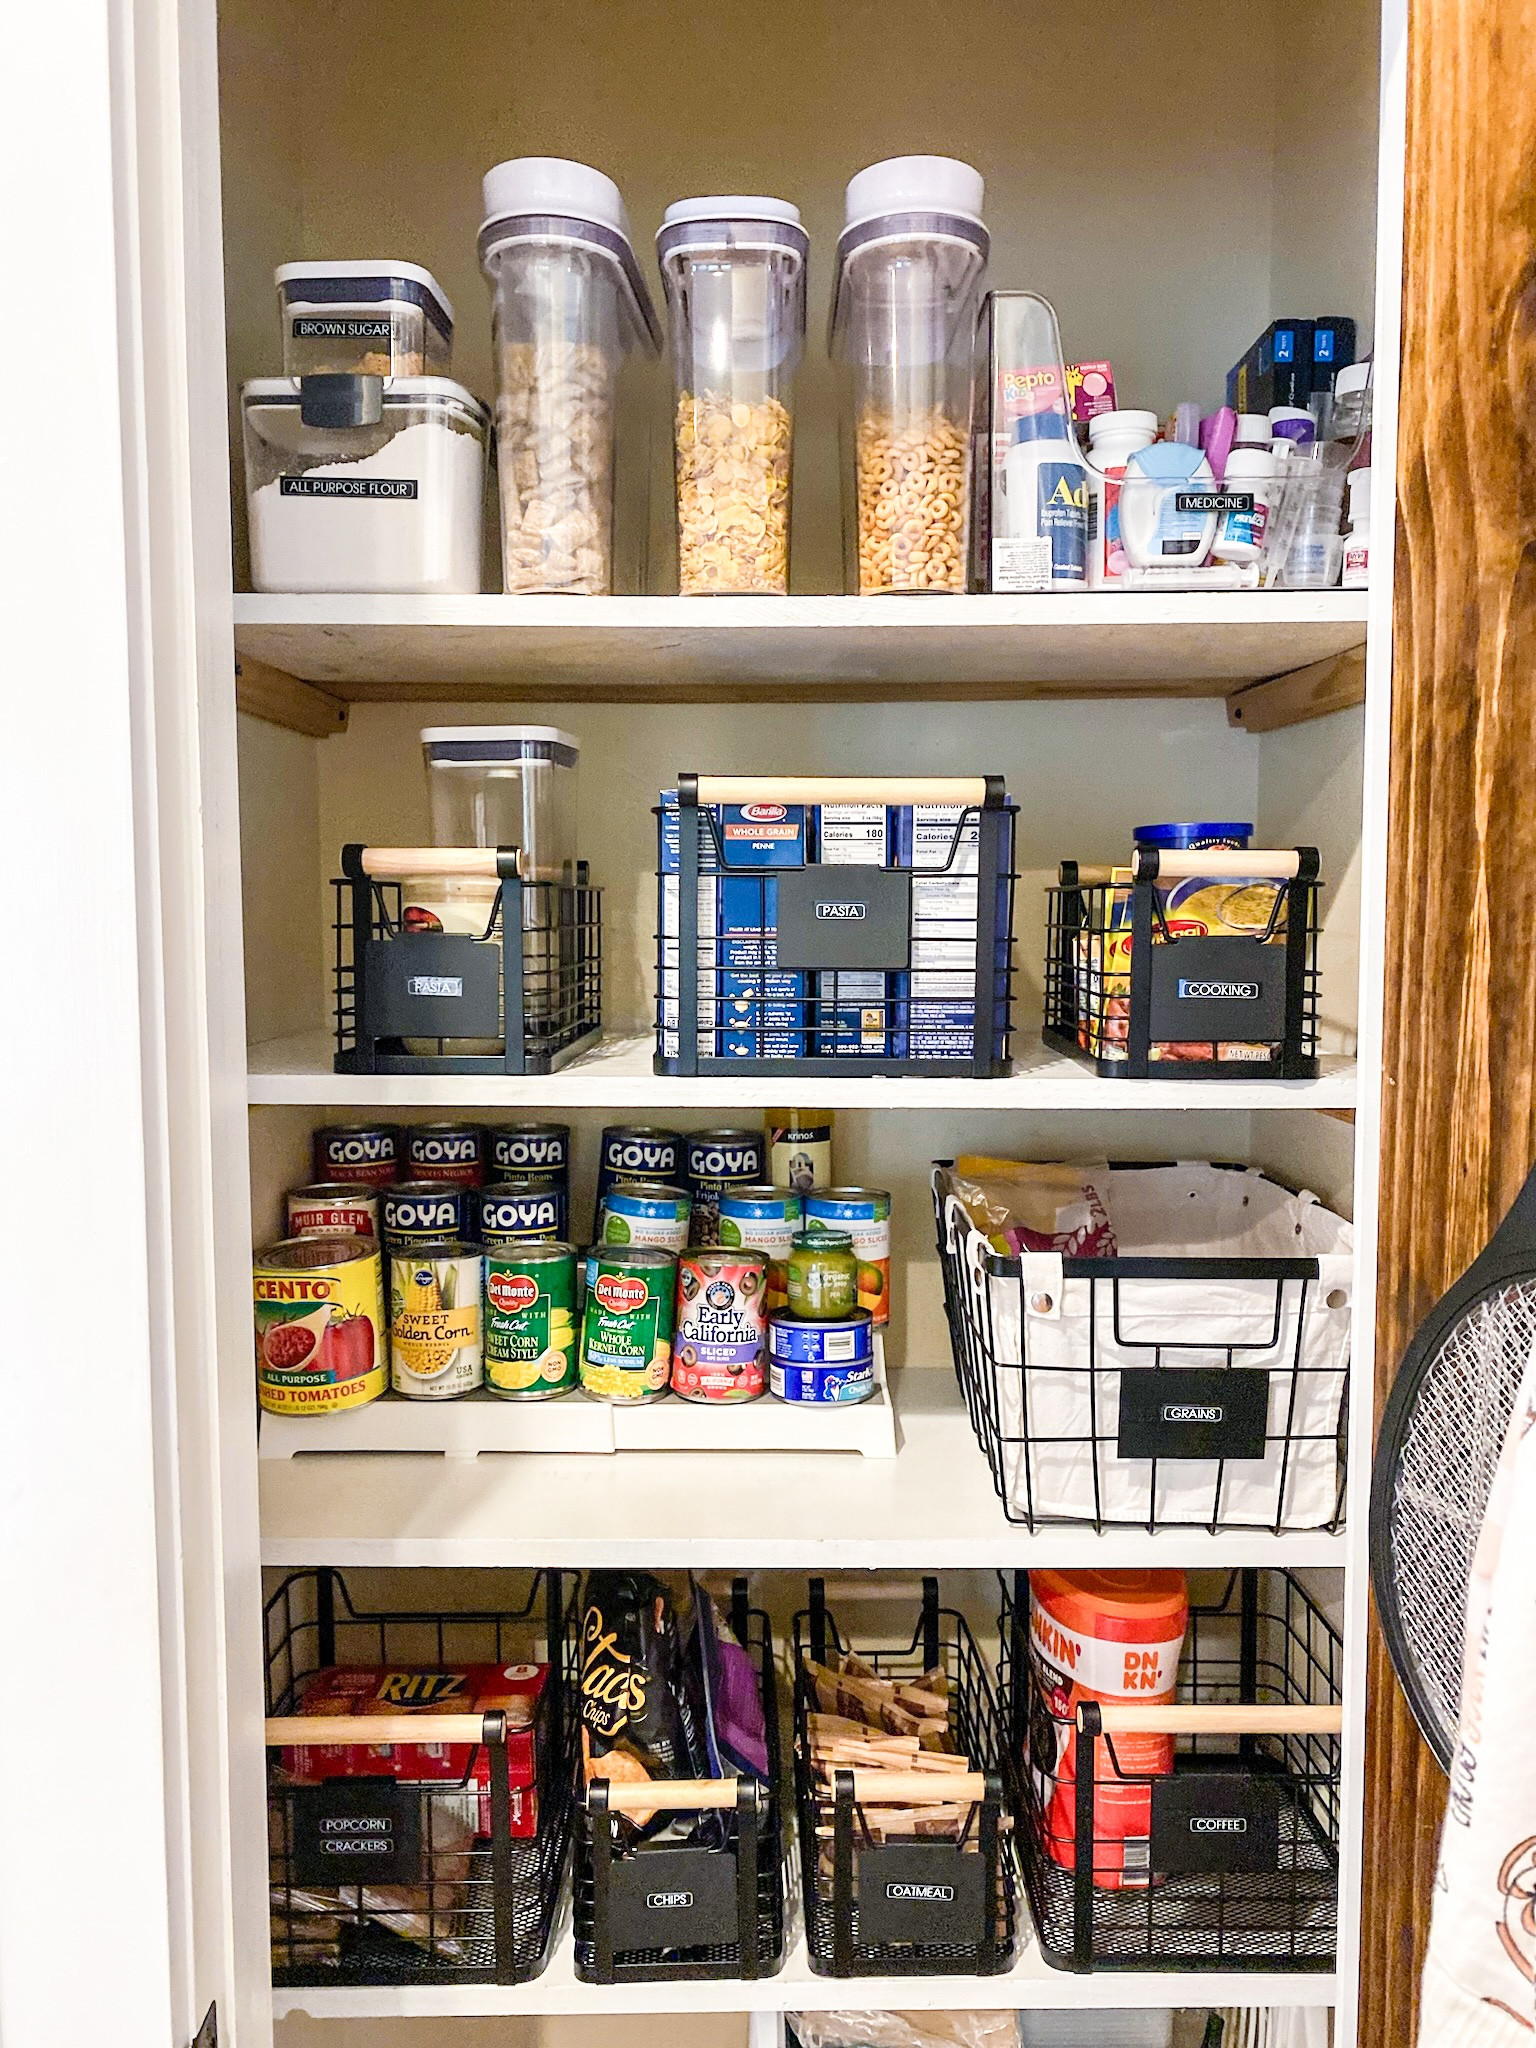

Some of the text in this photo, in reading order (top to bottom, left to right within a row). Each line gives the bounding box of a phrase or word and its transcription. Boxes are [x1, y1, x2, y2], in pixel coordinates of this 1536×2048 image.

[301, 322, 390, 336] BROWN SUGAR
[1279, 350, 1289, 358] 2
[1319, 349, 1329, 357] 2
[1004, 370, 1055, 392] Pepto
[289, 481, 408, 496] ALL PURPOSE FLOUR
[1185, 496, 1244, 510] MEDICINE
[750, 805, 783, 817] Barilla
[732, 827, 795, 836] WHOLE GRAIN
[823, 829, 883, 838] Calories 180
[916, 833, 954, 841] Calories
[752, 842, 775, 850] PENNE
[823, 905, 859, 917] PASTA
[1188, 984, 1252, 997] COOKING
[328, 1137, 395, 1163] GOYA
[411, 1139, 476, 1162] GOYA
[495, 1141, 562, 1164] GOYA
[608, 1143, 675, 1168] GOYA
[690, 1149, 759, 1173] GOYA
[503, 1171, 526, 1181] Pinto
[700, 1180, 721, 1191] Pinto
[294, 1211, 364, 1228] MUIR GLEN
[384, 1201, 456, 1228] GOYA
[482, 1201, 555, 1229] GOYA
[634, 1235, 666, 1243] MANGO
[744, 1236, 776, 1244] MANGO
[256, 1280, 331, 1300] CENTO
[501, 1284, 535, 1298] Monte
[597, 1283, 645, 1300] Del Monte
[403, 1314, 449, 1325] SWEET
[521, 1311, 547, 1319] WITH
[698, 1306, 744, 1330] Early
[490, 1316, 530, 1331] Fresh Cut
[392, 1322, 431, 1341] Golden
[600, 1331, 632, 1345] WHOLE
[683, 1320, 757, 1343] California
[510, 1334, 539, 1349] CORN
[588, 1337, 645, 1356] KERNEL CORN
[510, 1346, 538, 1359] STYLE
[700, 1346, 736, 1357] SLICED
[456, 1364, 473, 1375] USA
[267, 1373, 327, 1384] ALL PURPOSE
[289, 1380, 366, 1403] TOMATOES
[1170, 1407, 1216, 1420] GRAINS
[1124, 1651, 1159, 1671] DN
[1042, 1663, 1064, 1687] BLEND
[1123, 1670, 1163, 1690] KN'
[375, 1672, 468, 1700] RITZ
[326, 1819, 386, 1831] POPCORN
[1196, 1819, 1240, 1831] COFFEE
[325, 1840, 388, 1852] CRACKERS
[892, 1885, 948, 1899] OATMEAL
[653, 1893, 687, 1906] CHIPS
